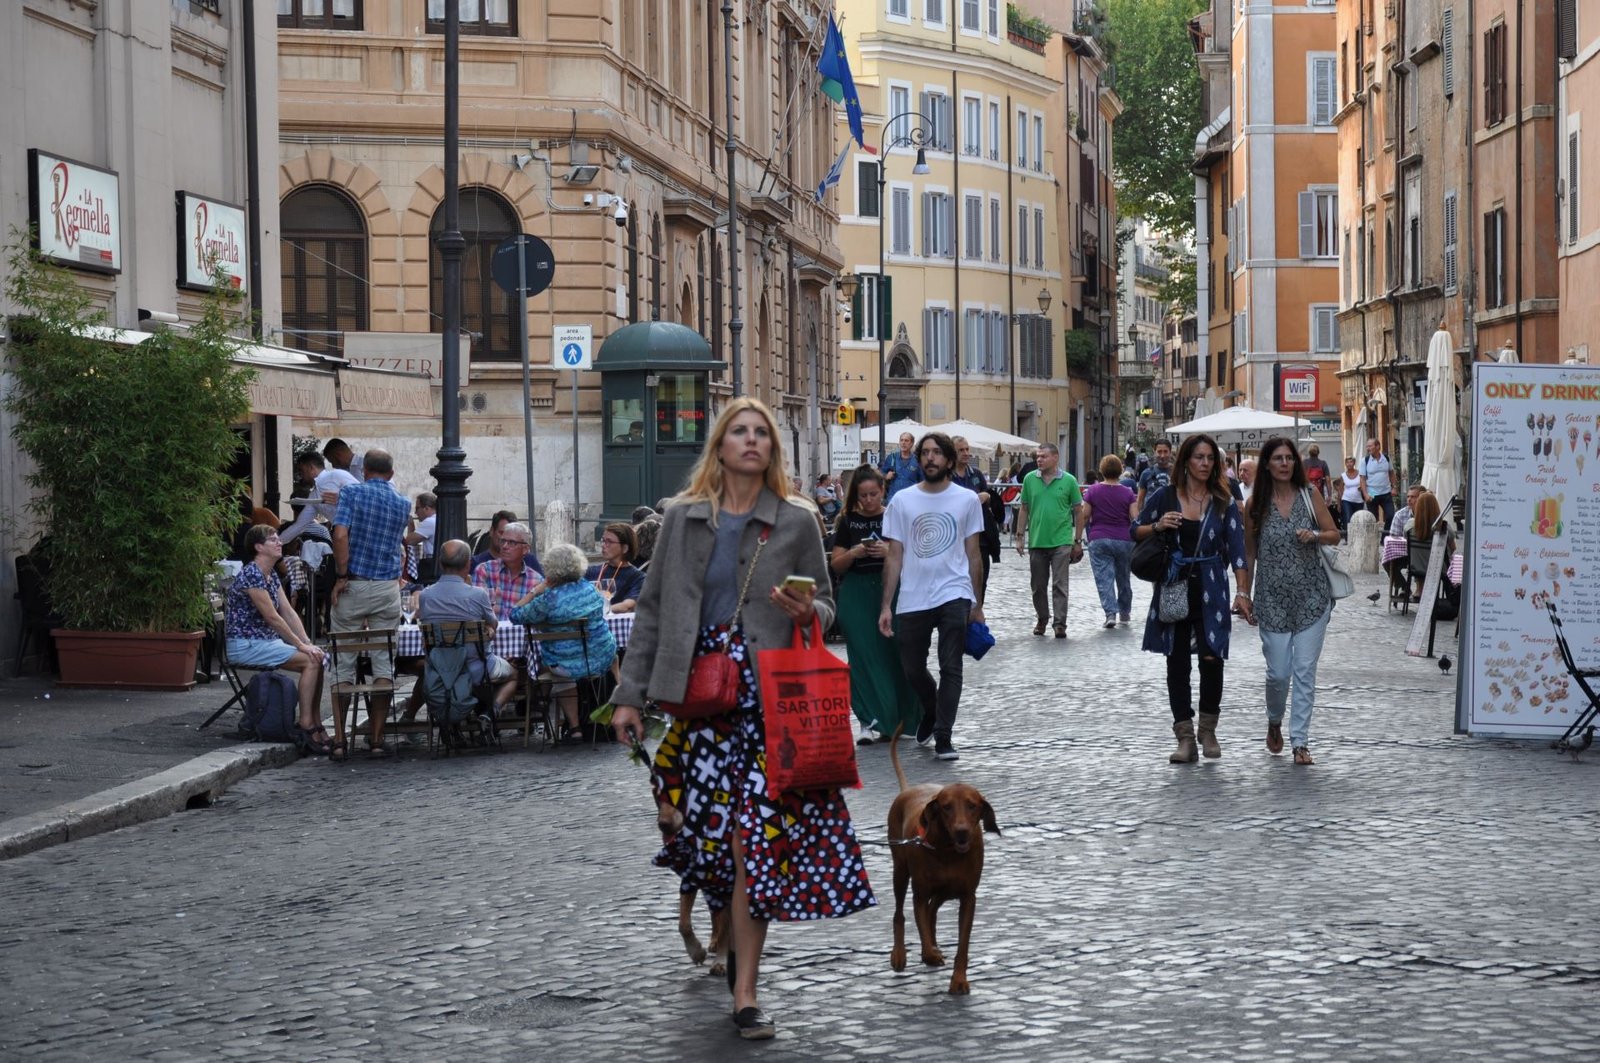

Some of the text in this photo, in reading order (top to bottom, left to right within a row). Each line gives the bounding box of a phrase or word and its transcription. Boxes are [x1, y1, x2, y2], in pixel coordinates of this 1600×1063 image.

[84, 188, 92, 206] LA
[50, 162, 110, 248] Reginella
[219, 223, 226, 239] LA
[1289, 382, 1311, 394] WiFi
[1485, 382, 1600, 400] ONLY DRINK
[1565, 413, 1592, 425] Gelati
[1537, 464, 1556, 475] Fresh
[1525, 474, 1568, 487] Orange Juice
[850, 521, 868, 529] PINK
[1481, 541, 1506, 552] Liquori
[1521, 635, 1560, 645] Tramezz
